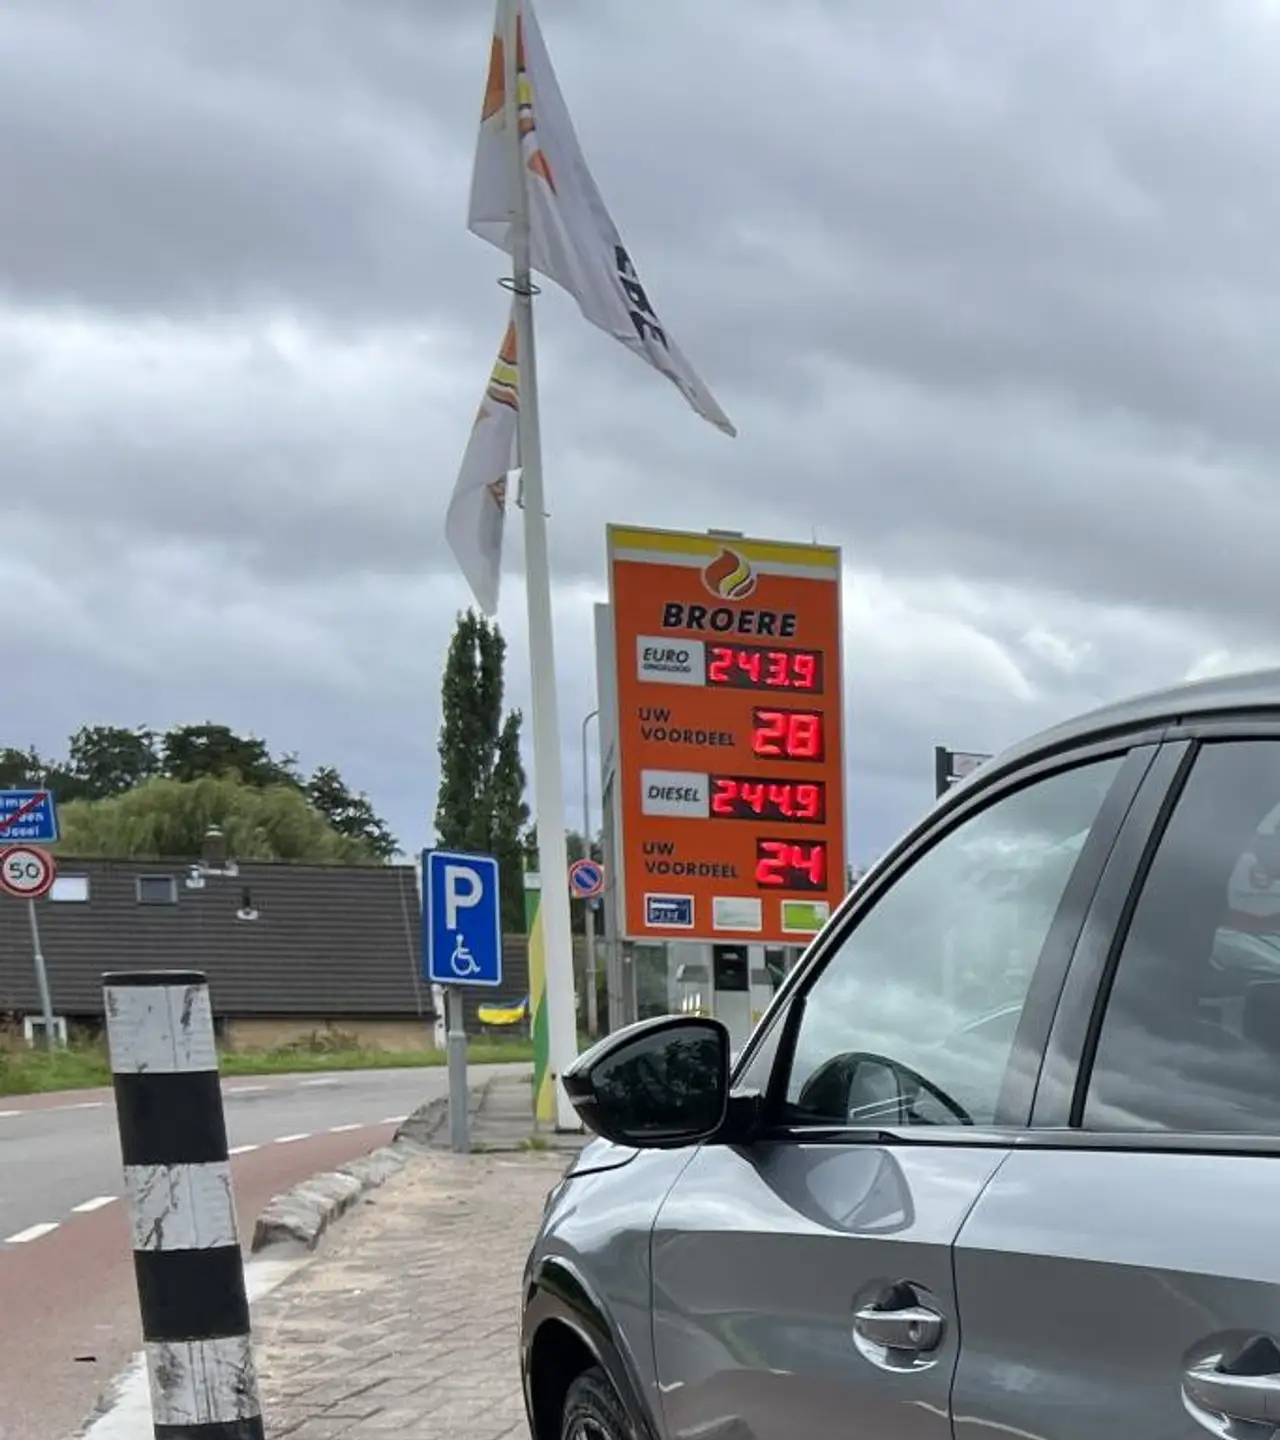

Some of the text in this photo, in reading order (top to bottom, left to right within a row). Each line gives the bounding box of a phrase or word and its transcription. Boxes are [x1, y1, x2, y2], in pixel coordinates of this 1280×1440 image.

[662, 602, 797, 637] BROERE
[642, 646, 690, 664] EURO
[638, 706, 671, 722] UW
[640, 709, 820, 757] VOORDEEL 28
[646, 785, 702, 802] DIESEL
[642, 840, 675, 856] UW
[8, 861, 40, 880] 50
[645, 841, 823, 885] VOORDEEL 24
[444, 865, 484, 930] P
